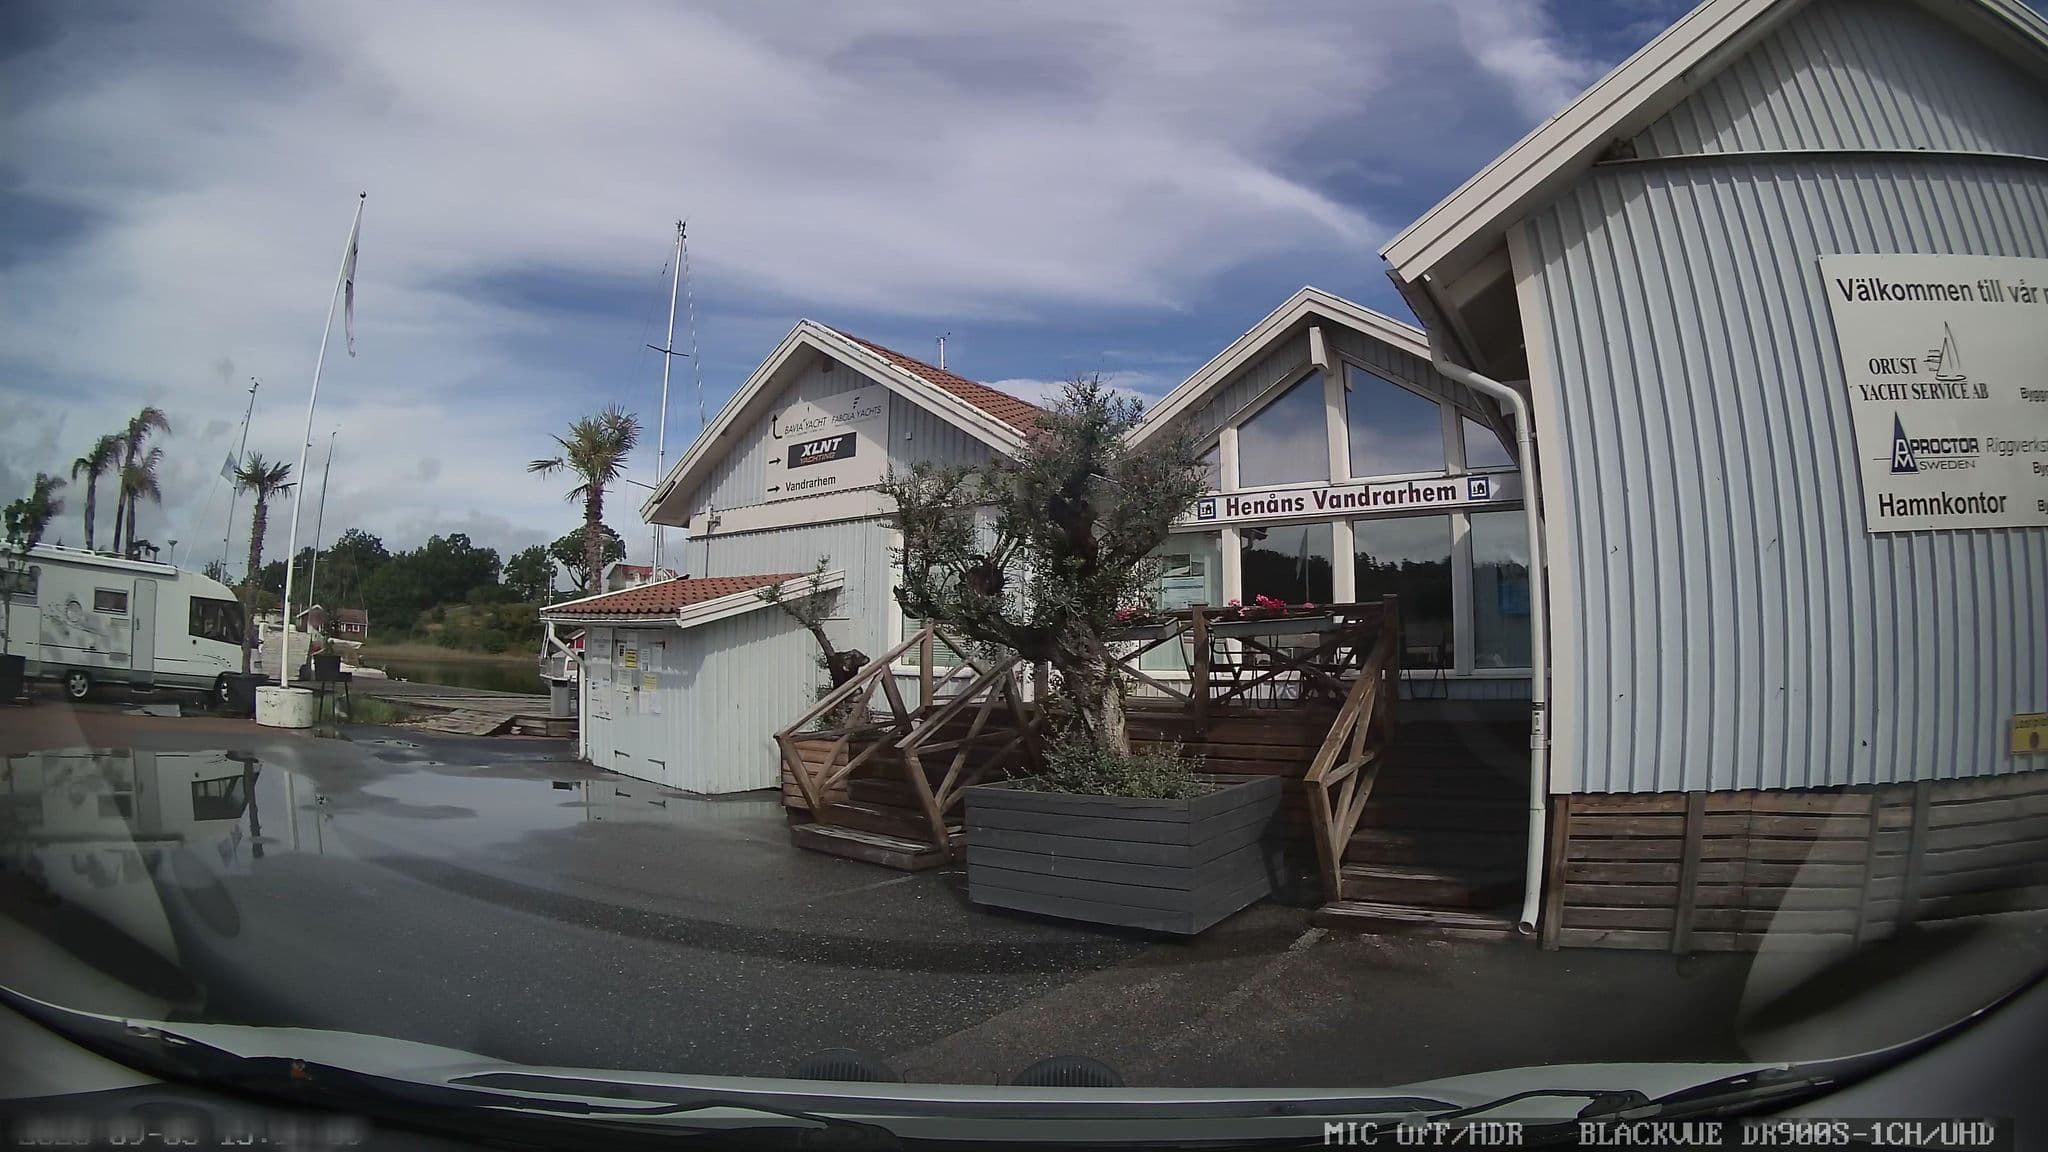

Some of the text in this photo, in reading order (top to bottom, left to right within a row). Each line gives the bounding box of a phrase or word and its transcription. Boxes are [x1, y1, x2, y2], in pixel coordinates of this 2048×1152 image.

[1836, 278, 1974, 302] Välkommen
[1977, 279, 2004, 303] till
[2007, 279, 2038, 303] vår
[1868, 358, 1918, 374] ORUST
[1859, 382, 1989, 400] YACHT SERVICE AB
[856, 405, 881, 417] YACHTS
[784, 422, 803, 435] BAVIA
[804, 416, 827, 430] YACHT
[801, 438, 842, 457] XLNT
[1910, 438, 1979, 454] PROCTOR
[1919, 460, 1976, 470] SWEDEN
[785, 476, 836, 492] Vandrarhem
[1226, 482, 1457, 517] Henåns Vandrarhem
[1878, 491, 2007, 517] Hamnkontor
